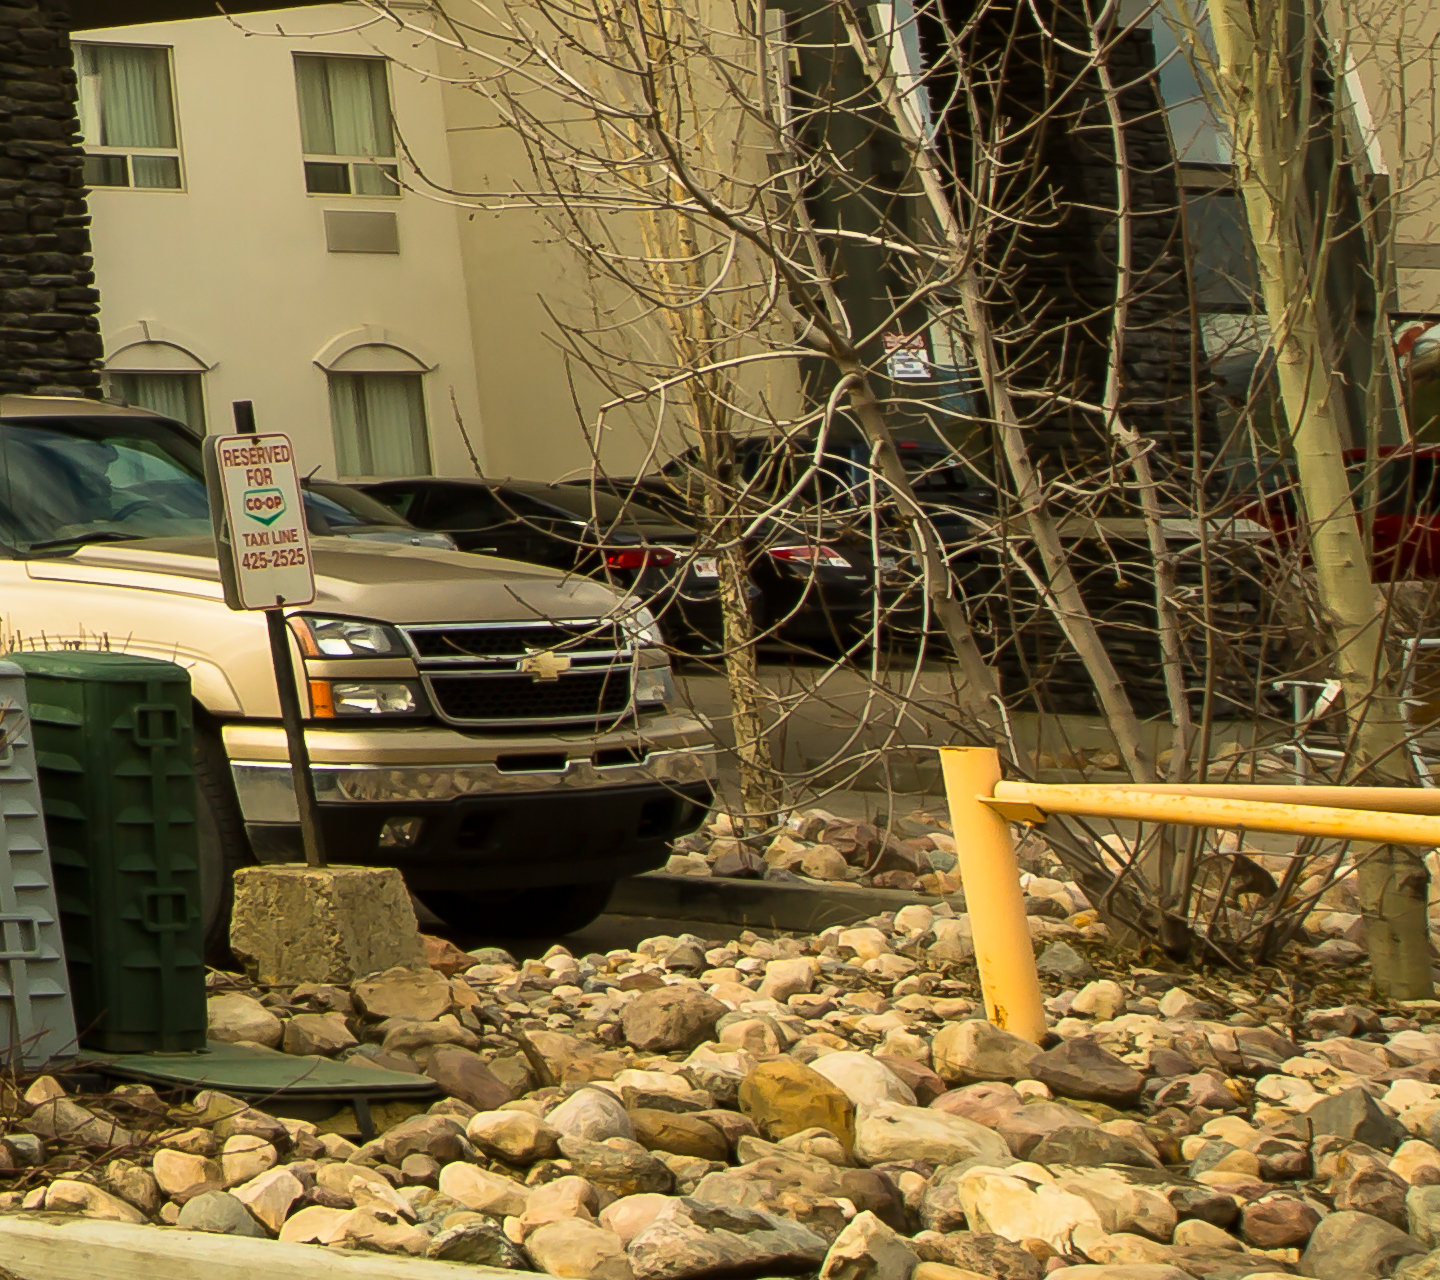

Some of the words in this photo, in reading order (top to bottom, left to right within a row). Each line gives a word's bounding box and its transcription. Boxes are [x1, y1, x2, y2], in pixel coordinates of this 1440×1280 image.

[222, 445, 290, 467] RESERVED
[246, 468, 273, 486] FOR
[246, 496, 282, 510] CO-OP
[242, 532, 270, 547] TAXI
[272, 529, 299, 544] LINE
[242, 548, 305, 569] 425-2525
